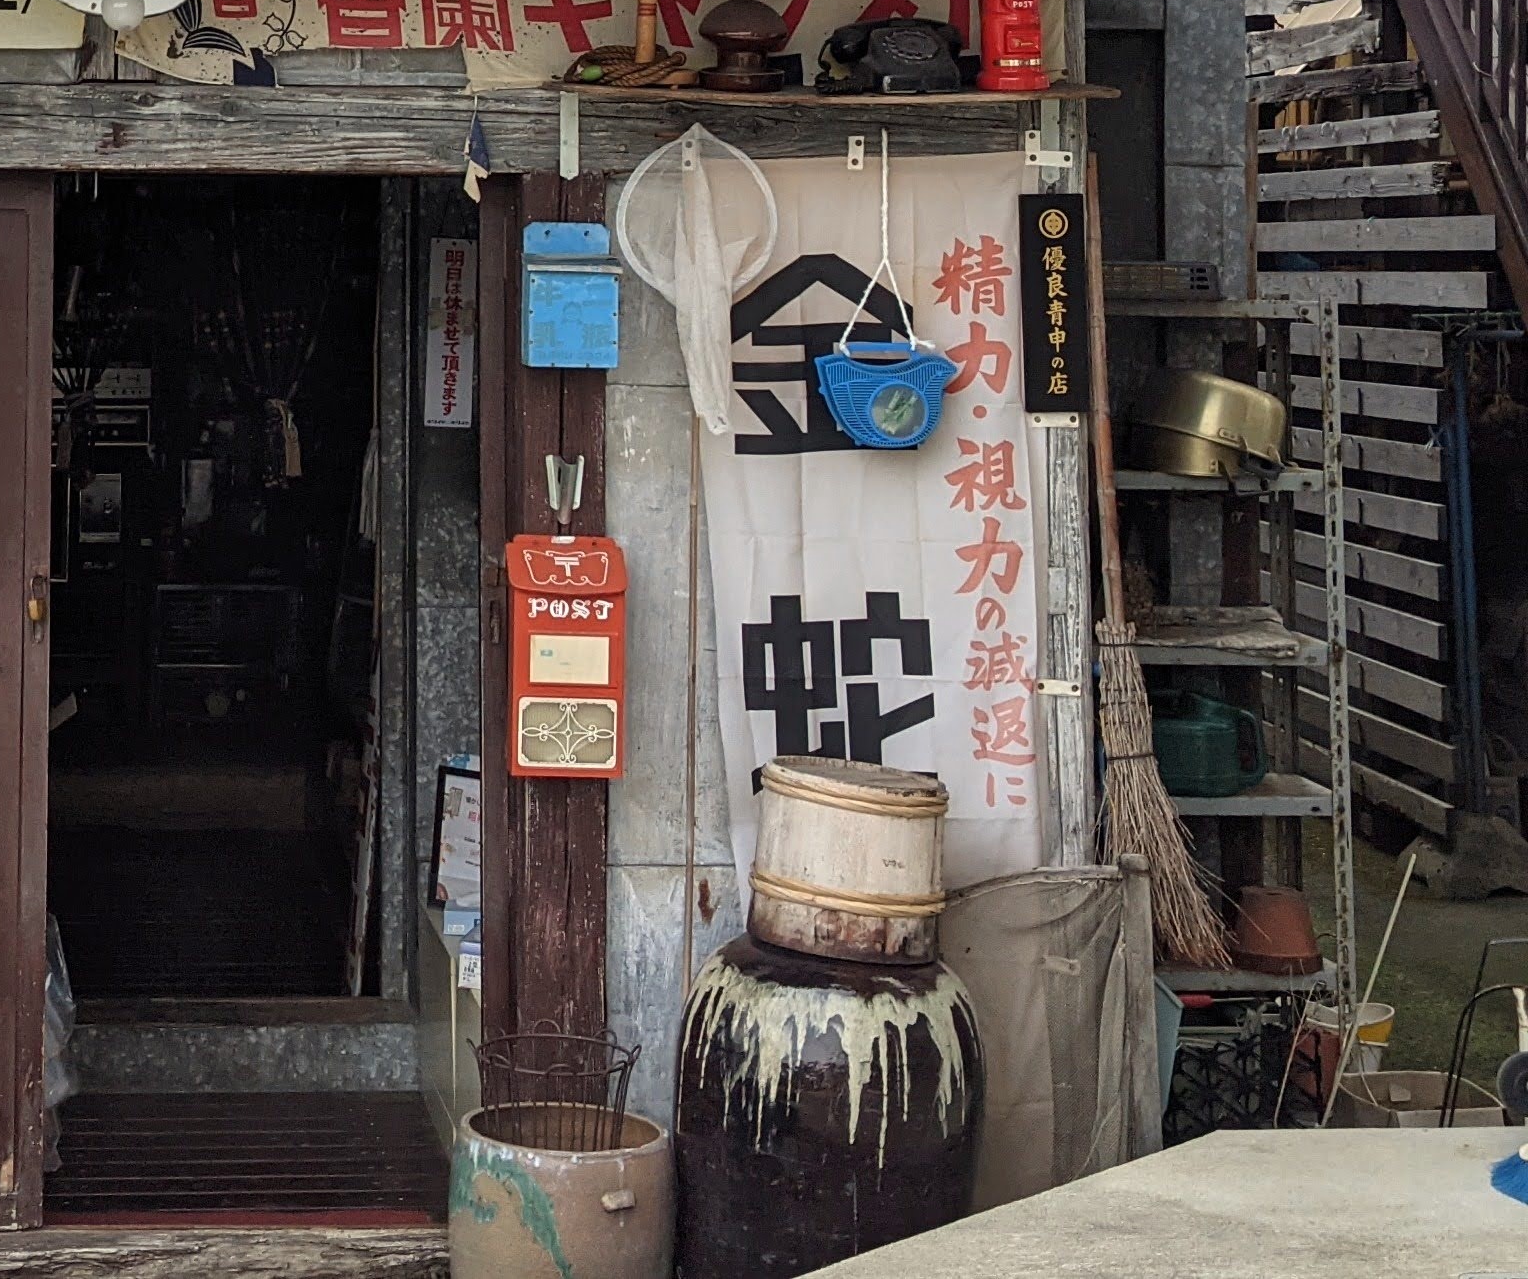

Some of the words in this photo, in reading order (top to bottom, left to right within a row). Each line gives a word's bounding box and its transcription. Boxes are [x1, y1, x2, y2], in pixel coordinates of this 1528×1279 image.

[1041, 245, 1070, 395] 優良青申の店
[931, 234, 1037, 808] 精力・視力の減退に
[527, 597, 614, 620] POST
